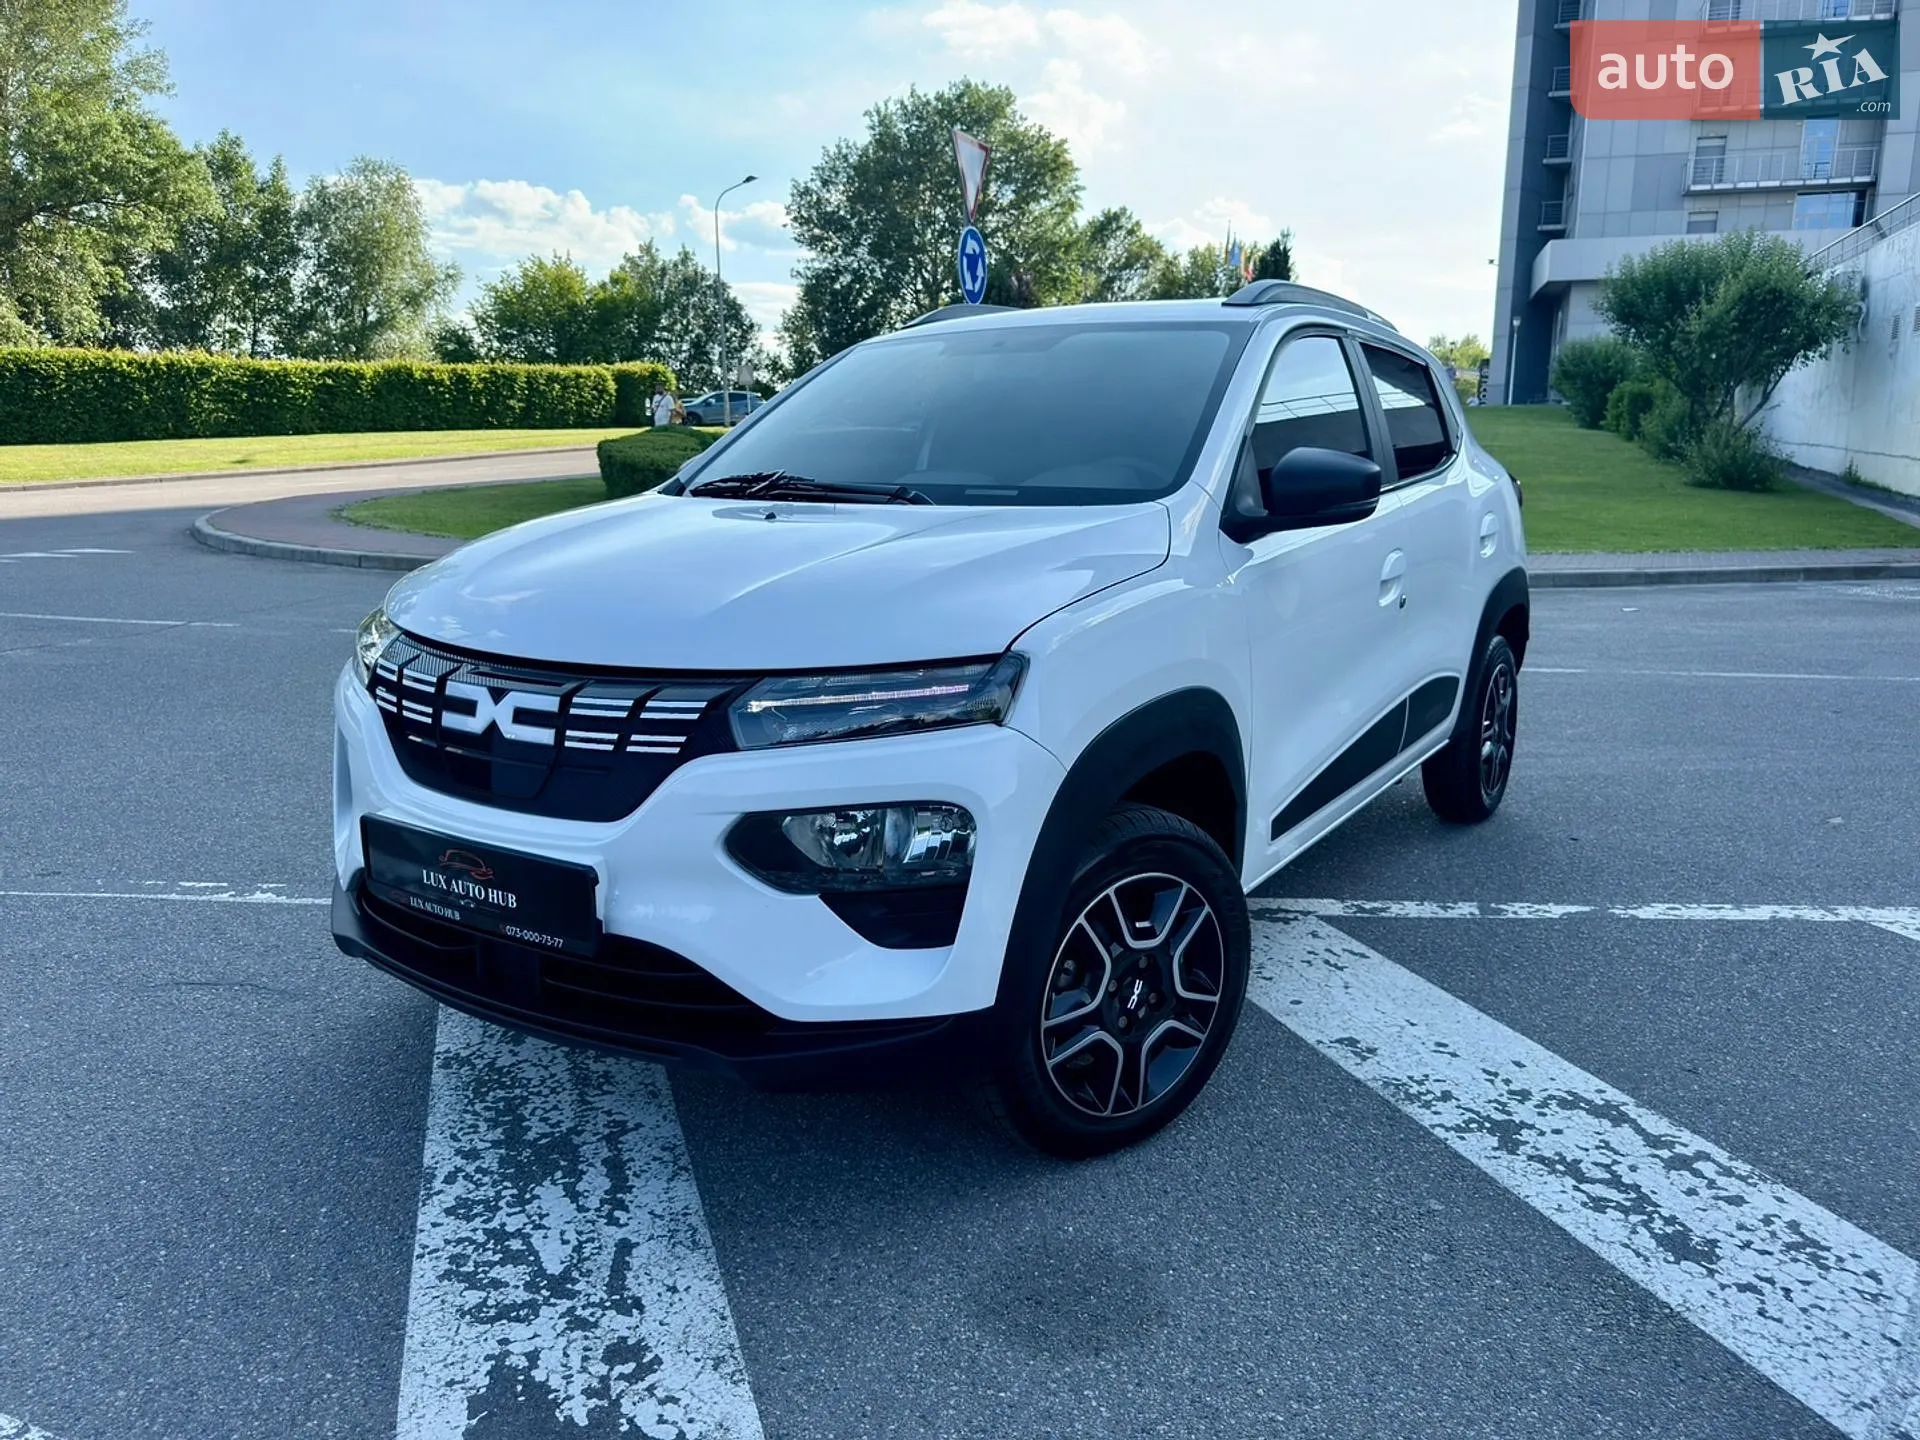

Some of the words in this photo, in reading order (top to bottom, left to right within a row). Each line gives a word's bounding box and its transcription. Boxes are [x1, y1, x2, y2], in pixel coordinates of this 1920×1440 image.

[422, 869, 447, 891] LUX
[449, 879, 486, 901] AUTO
[487, 887, 518, 909] HUB
[410, 895, 424, 909] LUX
[424, 901, 444, 917] AUTO
[505, 925, 564, 949] 073-000-73-77
